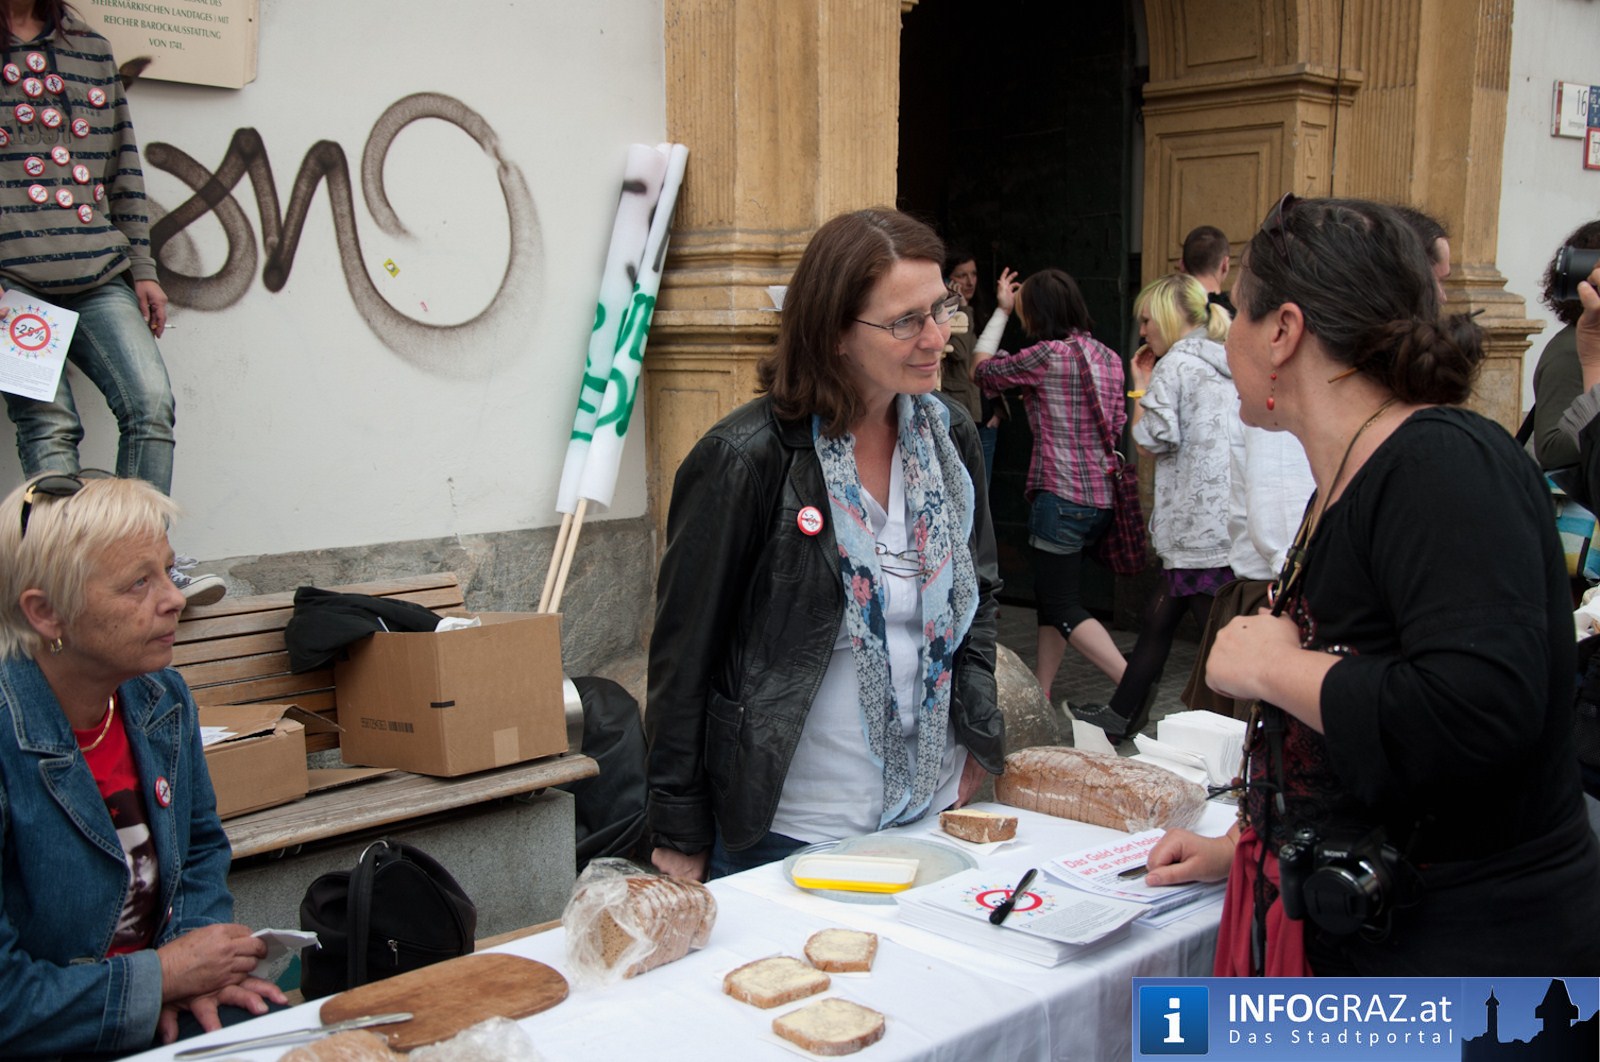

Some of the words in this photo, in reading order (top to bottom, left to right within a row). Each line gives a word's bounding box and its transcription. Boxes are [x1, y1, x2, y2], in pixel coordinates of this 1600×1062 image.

[104, 15, 139, 27] REICHER
[140, 19, 222, 40] BAROCKAUSSTATTUNG
[149, 38, 167, 49] VON
[1577, 89, 1588, 117] 16
[16, 324, 45, 342] -25%
[1062, 858, 1089, 869] Das
[1085, 848, 1114, 861] Geld
[1113, 841, 1137, 854] dort
[1323, 850, 1348, 858] SONY
[1079, 867, 1099, 876] wo
[1098, 862, 1113, 871] es
